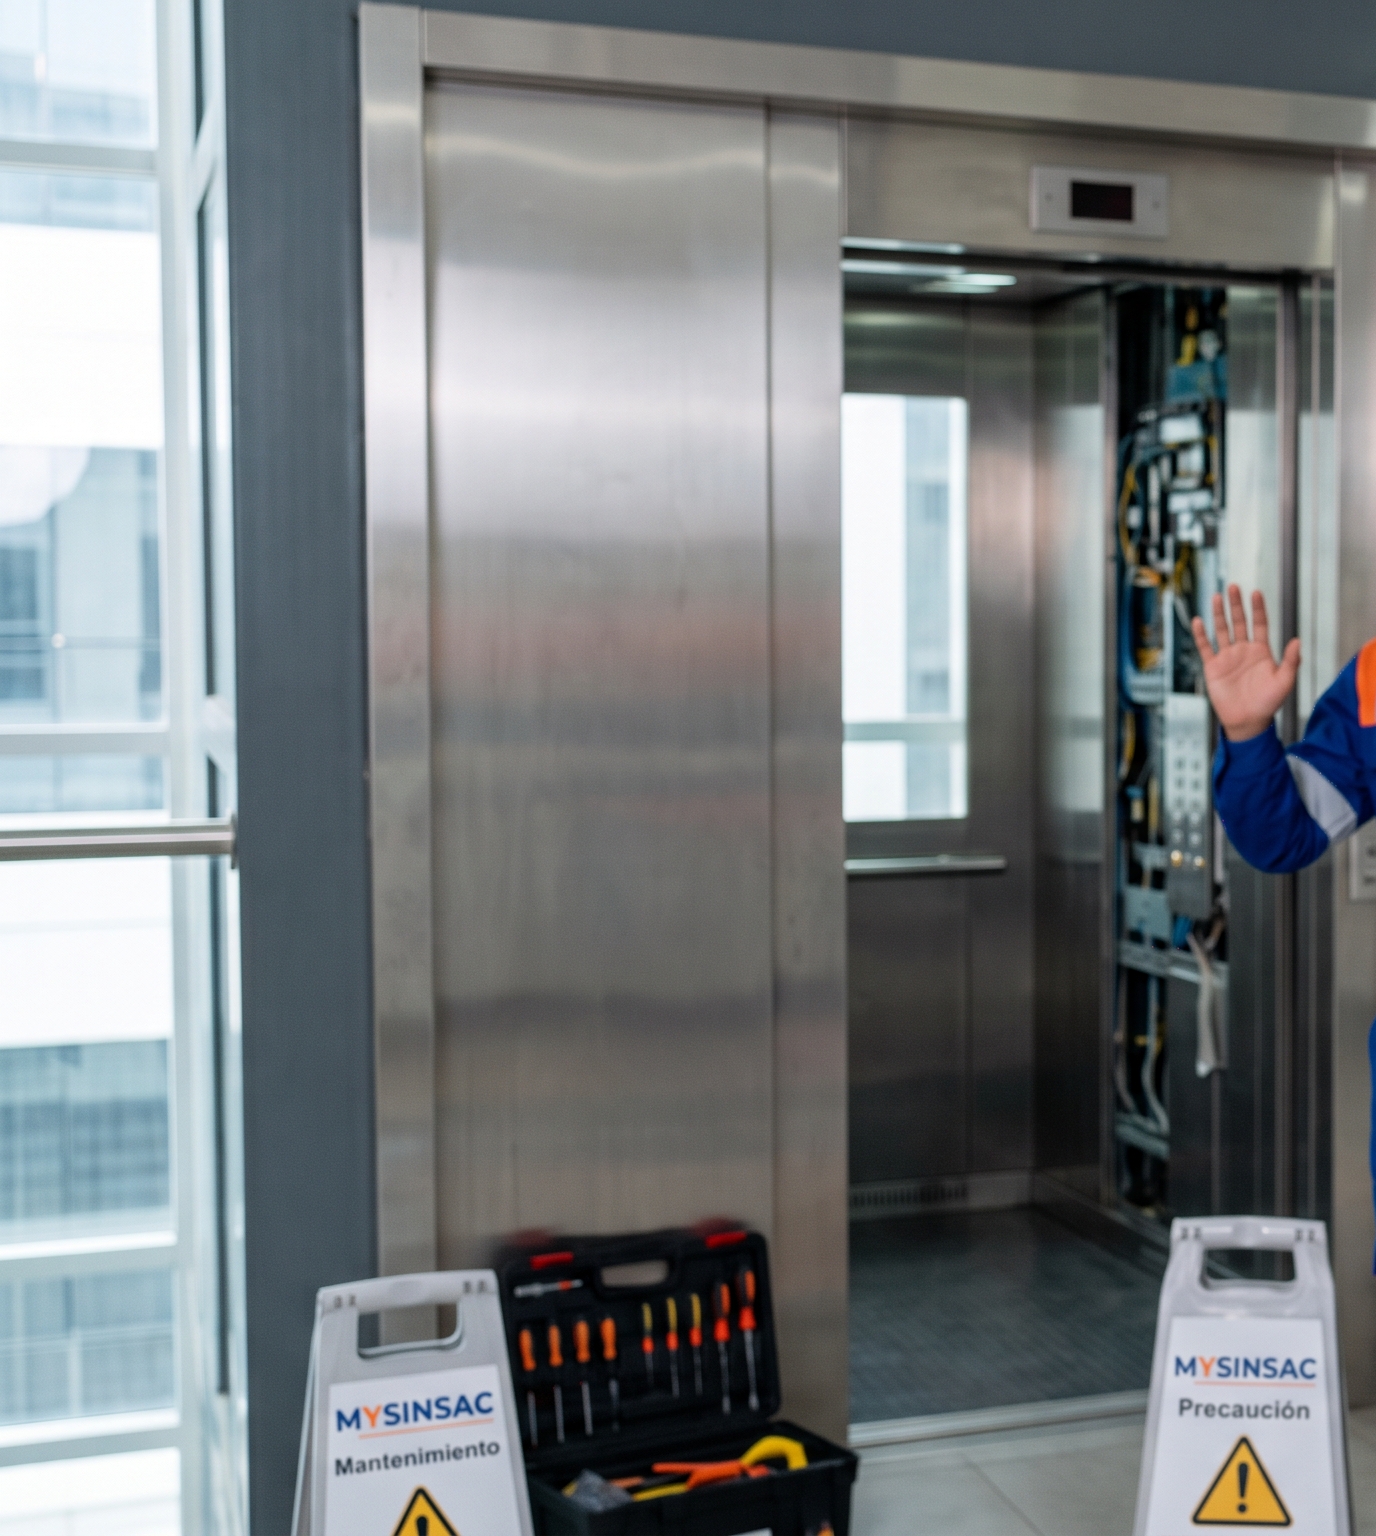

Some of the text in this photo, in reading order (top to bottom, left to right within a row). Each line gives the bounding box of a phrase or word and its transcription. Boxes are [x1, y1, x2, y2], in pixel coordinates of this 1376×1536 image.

[1174, 1356, 1317, 1380] MYSINSAC
[336, 1392, 494, 1432] MYSINSAC
[1178, 1398, 1310, 1420] Precaución
[335, 1441, 500, 1476] Mantenimiento
